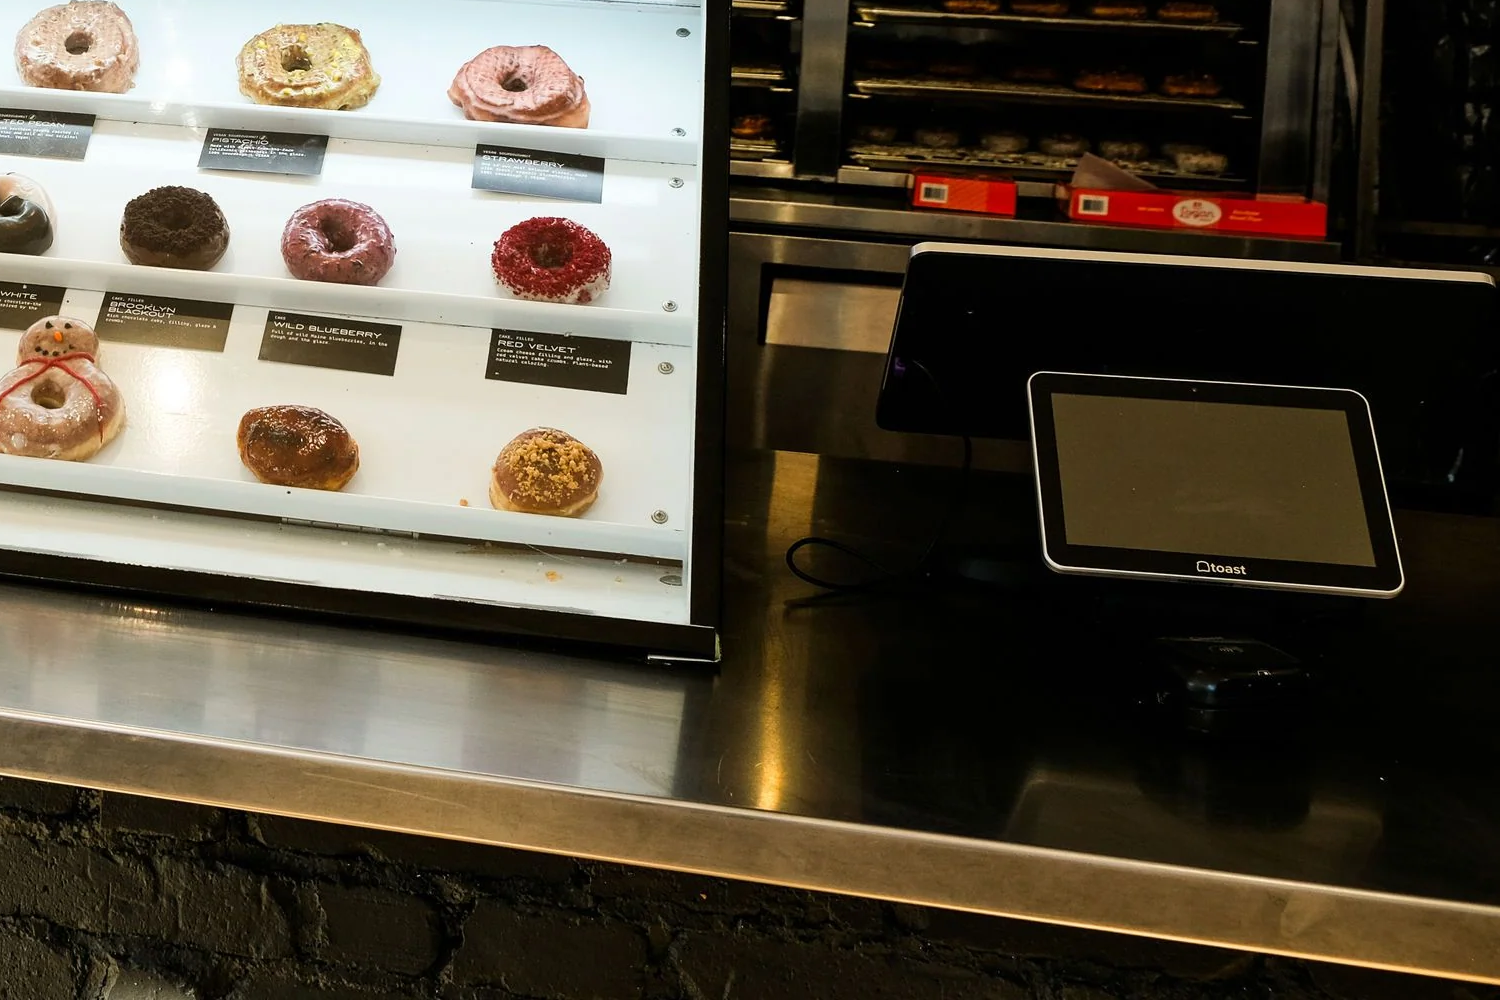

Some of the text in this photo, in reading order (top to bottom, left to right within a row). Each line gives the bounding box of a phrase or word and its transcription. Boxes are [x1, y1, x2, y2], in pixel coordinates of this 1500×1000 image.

[482, 155, 564, 168] STRAWBERRY
[0, 291, 38, 300] WHITE
[108, 306, 174, 319] BLACKOUT
[109, 301, 176, 314] BROOKLYN
[274, 321, 382, 339] WILD BLUEBERRY
[498, 340, 576, 353] RED VELVET
[1210, 562, 1247, 575] toast
